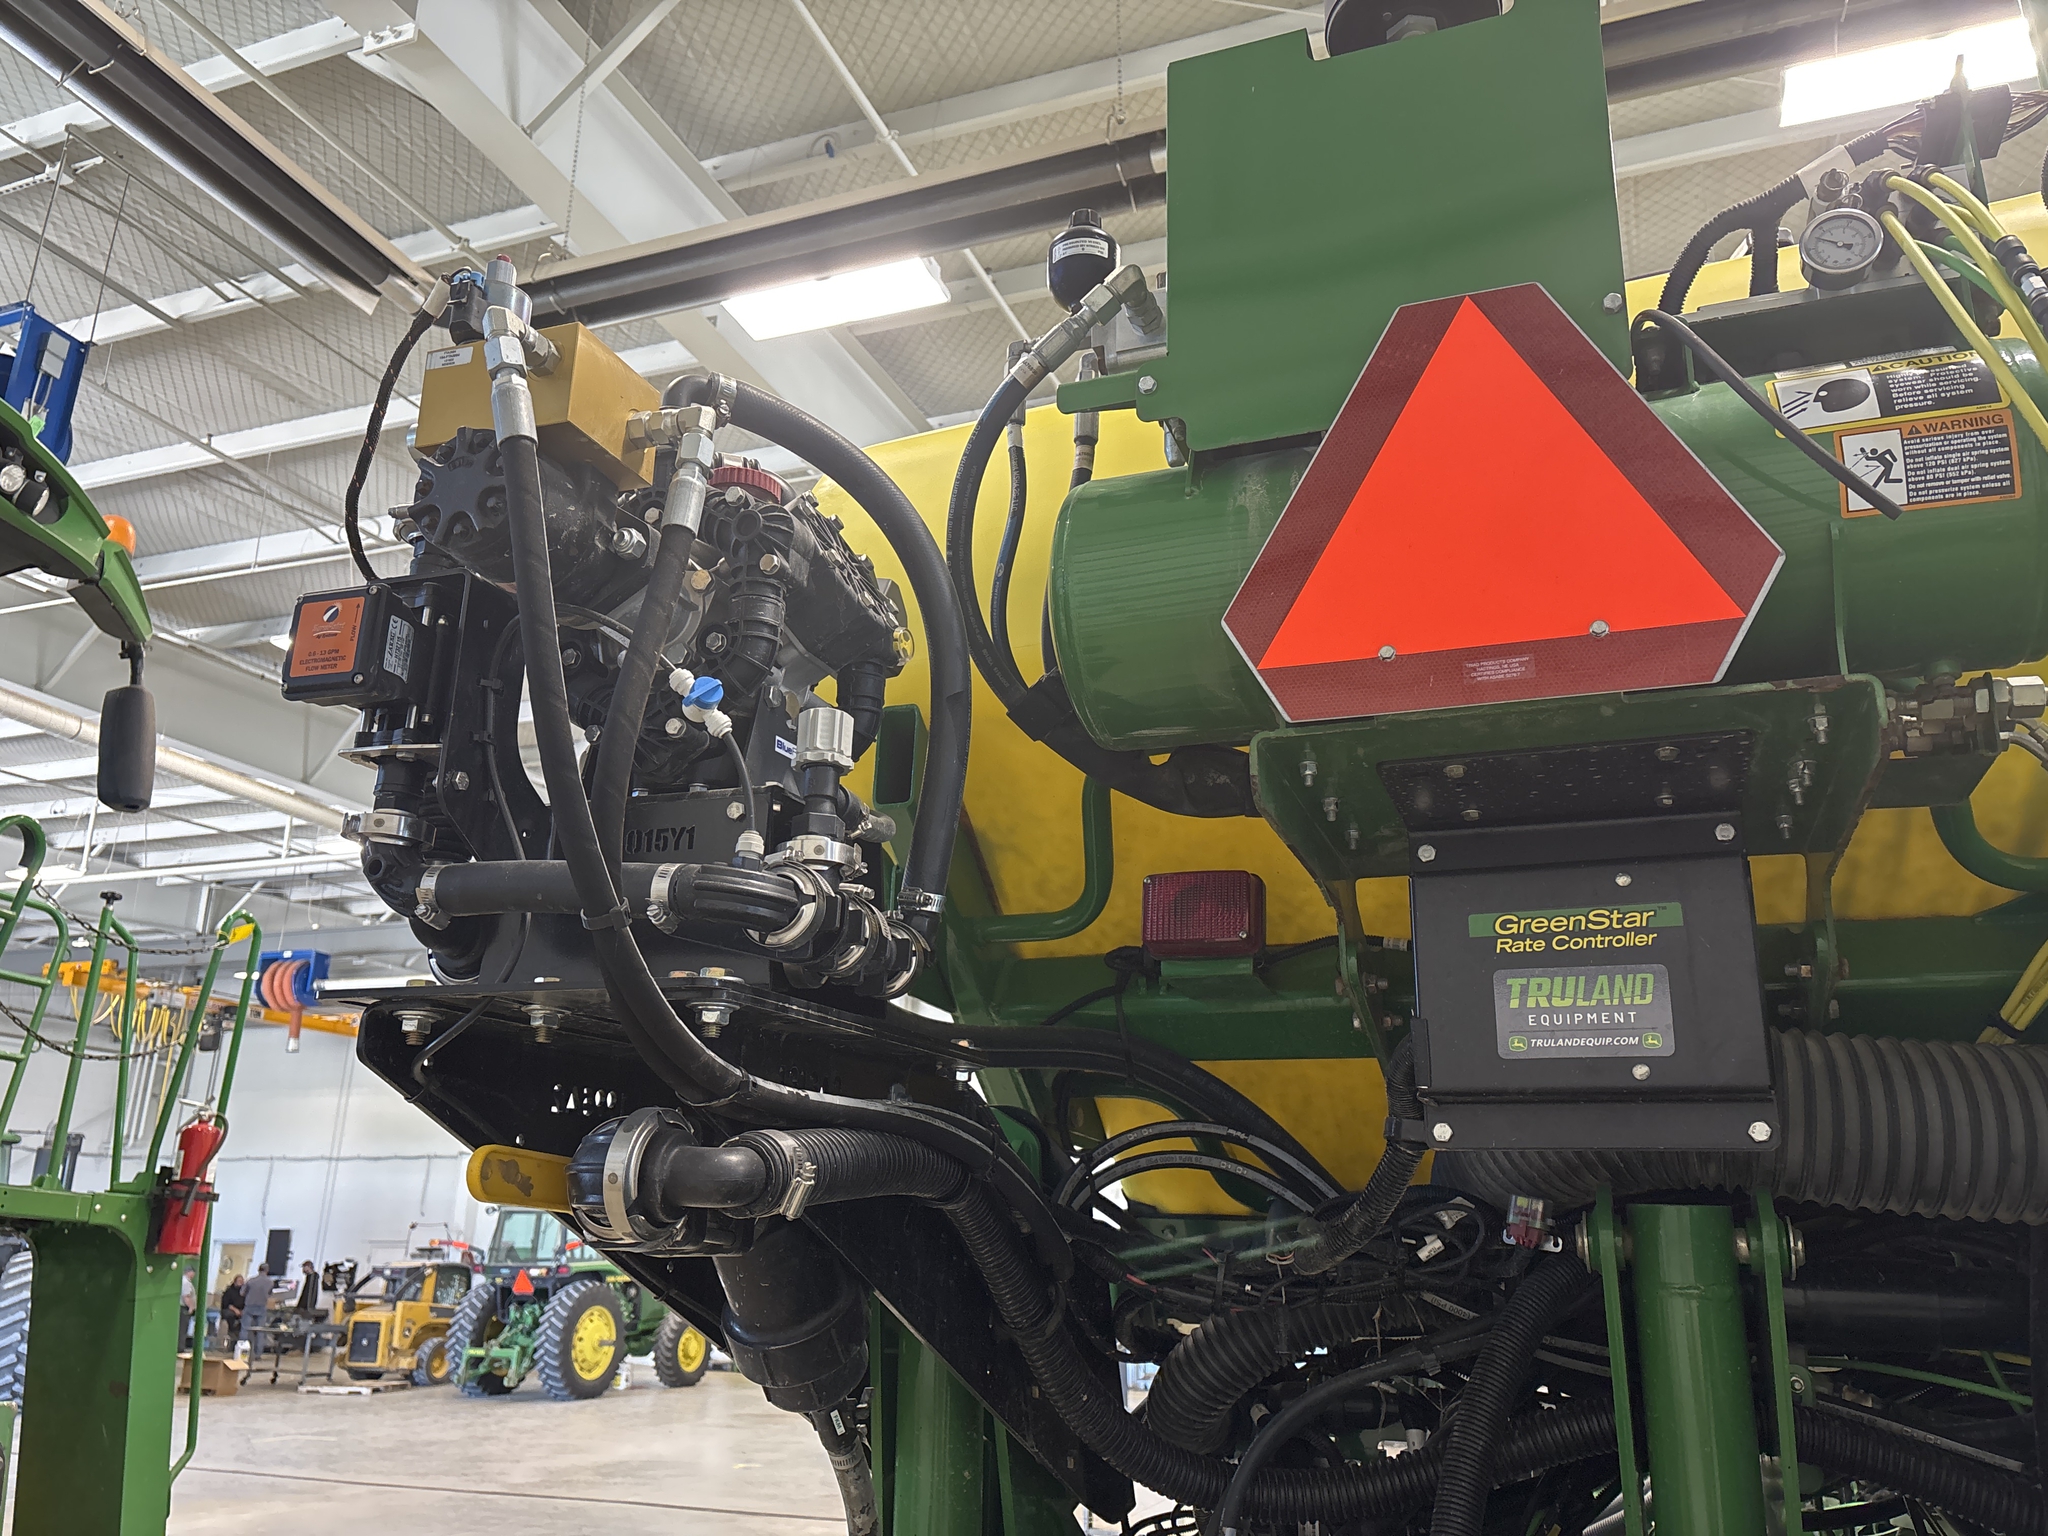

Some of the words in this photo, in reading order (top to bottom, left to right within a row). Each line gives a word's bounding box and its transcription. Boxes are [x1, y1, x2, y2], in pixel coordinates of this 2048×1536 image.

[1888, 376, 1924, 384] system.
[1930, 367, 1978, 376] Protective
[1889, 379, 1926, 388] eyewear
[1929, 374, 1959, 382] should
[1939, 376, 1981, 386] servicing.
[1892, 390, 1921, 398] Before
[1924, 384, 1965, 393] servicing
[1893, 395, 1924, 404] relieve
[1940, 389, 1973, 397] system
[1895, 400, 1935, 411] pressure.
[1923, 414, 2004, 433] WARNING
[950, 480, 960, 519] Resistant
[956, 455, 969, 480] MSHA
[959, 515, 967, 544] Engineered
[299, 655, 346, 665] ELECTROMAGNETIC
[1493, 908, 1656, 936] GreenStar
[1495, 939, 1546, 955] Rate
[1551, 932, 1658, 950] Controller
[1506, 972, 1654, 1009] TRULAND
[1528, 1011, 1638, 1027] EQUIPMENT
[1530, 1035, 1639, 1048] TRULANDEQUIP.COM
